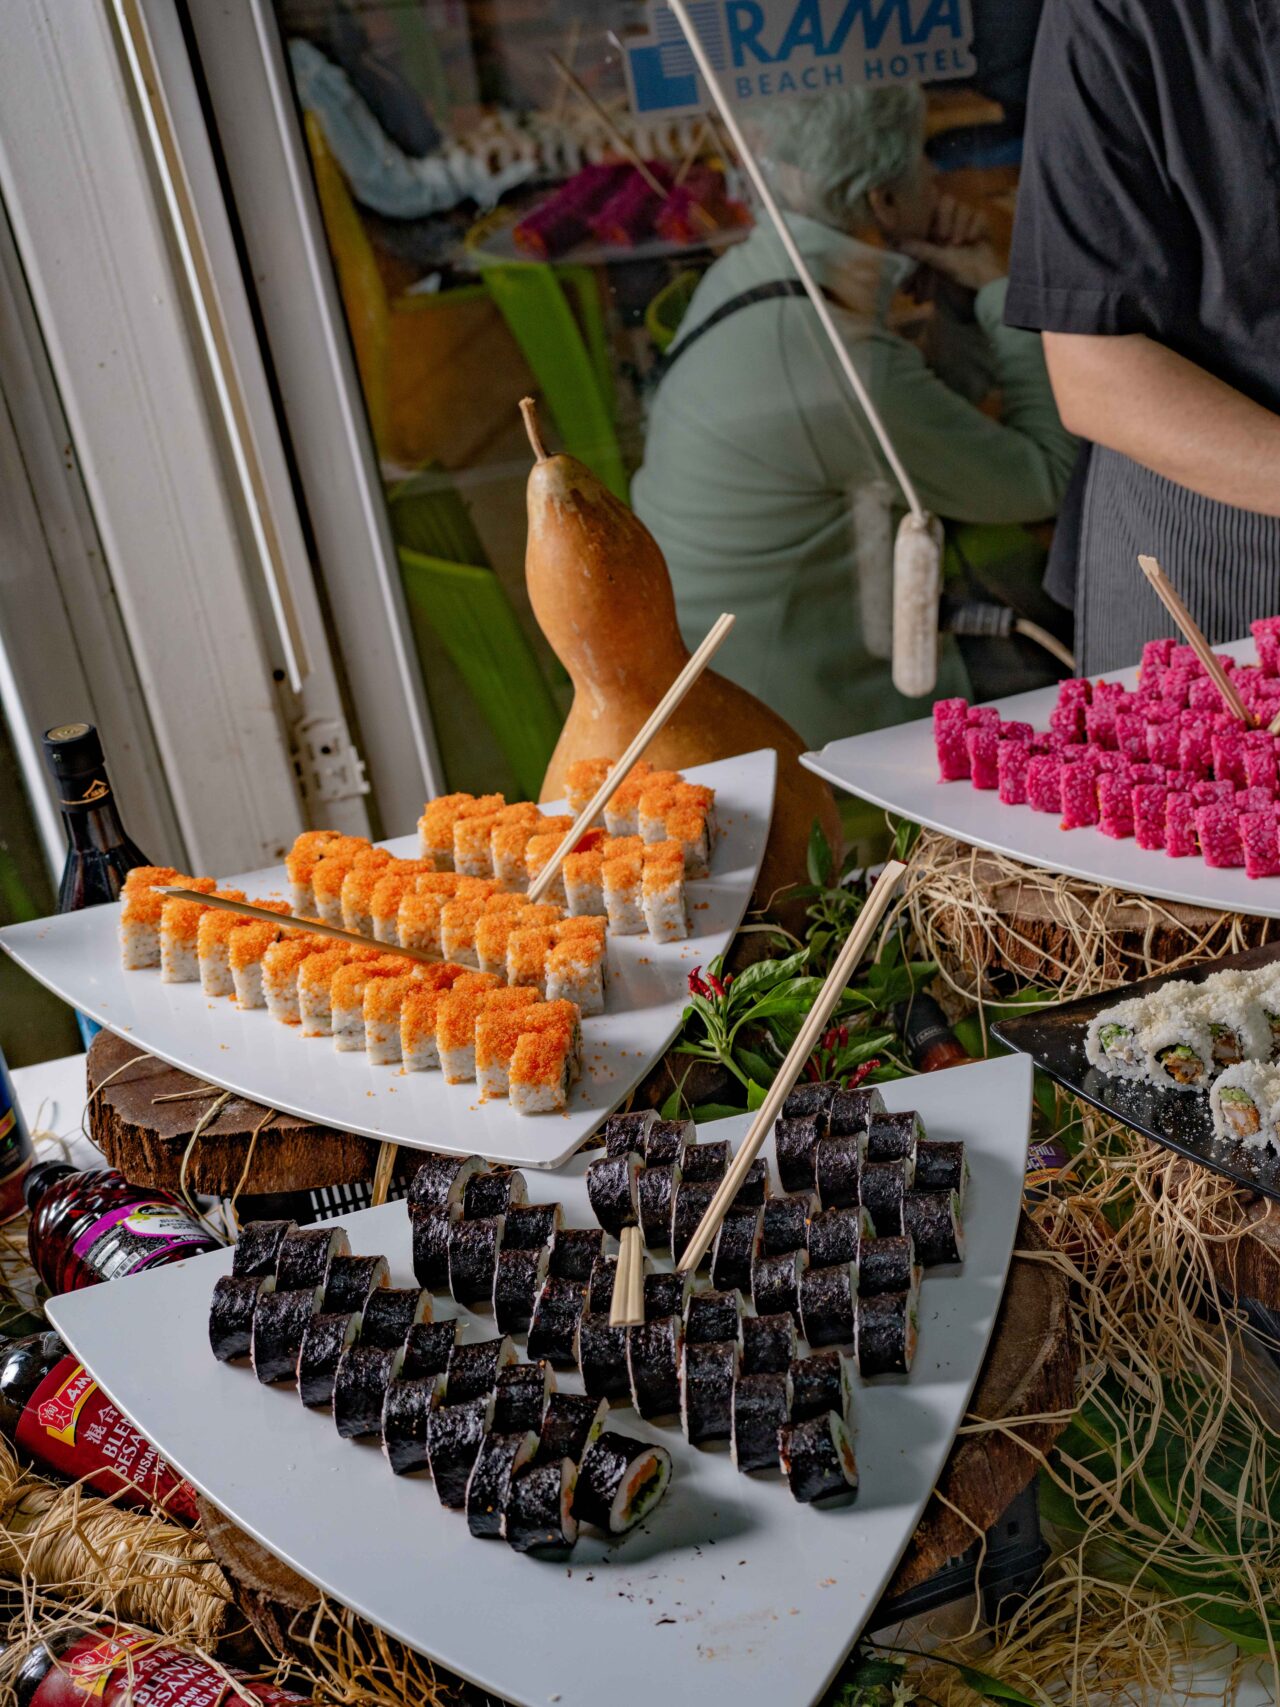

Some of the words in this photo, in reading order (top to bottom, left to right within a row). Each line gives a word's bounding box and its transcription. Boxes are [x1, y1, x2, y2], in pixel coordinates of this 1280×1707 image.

[726, 0, 963, 67] RAMA
[736, 64, 844, 99] BEACH
[864, 48, 967, 80] HOTEL
[66, 1369, 94, 1402] AM
